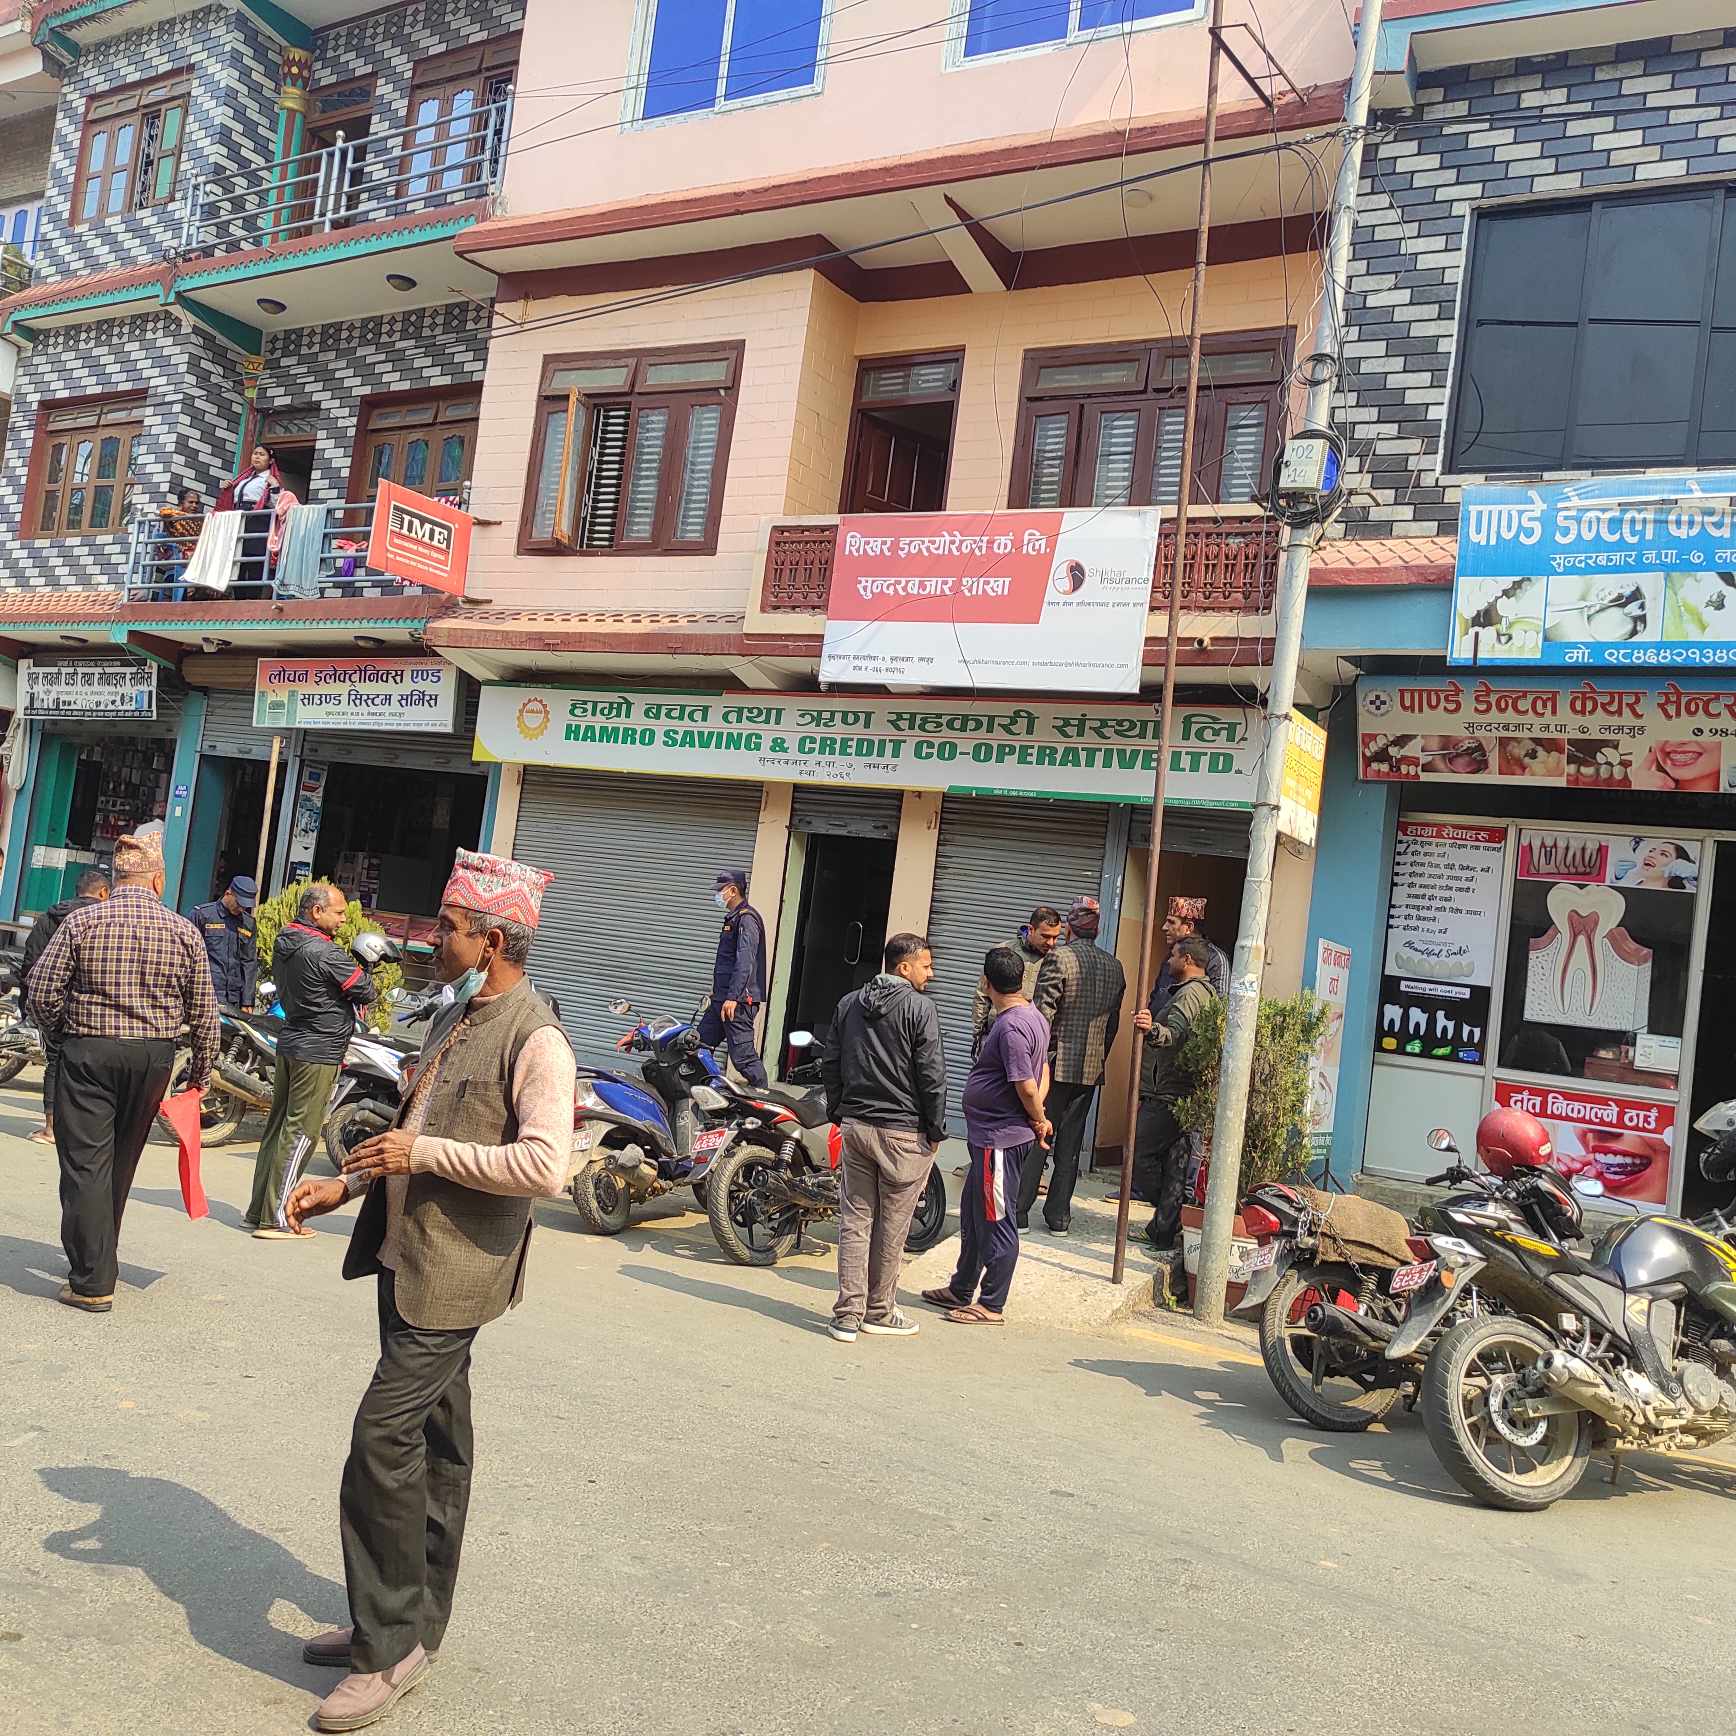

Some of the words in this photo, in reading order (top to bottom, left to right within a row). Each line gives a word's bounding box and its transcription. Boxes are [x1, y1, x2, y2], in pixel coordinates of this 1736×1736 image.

[1468, 491, 1547, 545] पाण्डे
[1668, 480, 1736, 538] केय
[400, 514, 448, 550] IME
[845, 532, 895, 556] शिखर
[1022, 529, 1050, 555] लि.
[1088, 568, 1126, 578] Shikhar
[1550, 552, 1637, 572] सुन्दरबजार
[857, 576, 956, 599] सुन्दरबजार
[960, 576, 1012, 596] शाखा
[1100, 569, 1149, 584] Insurance
[1564, 645, 1593, 663] मो.
[81, 672, 95, 687] तथा
[98, 667, 127, 689] मोबाइल
[268, 665, 309, 684] लोचन
[313, 664, 405, 688] इलेक्ट्रोनिक्स
[410, 668, 442, 684] एण्ड
[300, 693, 341, 708] साउण्ड
[347, 689, 393, 708] सिस्टम
[397, 689, 439, 708] सर्भिस
[1398, 680, 1465, 715] पाण्डे
[1472, 680, 1560, 718] डेन्टल
[1569, 680, 1648, 719] केयर
[569, 696, 635, 720] हाम्रो
[643, 702, 712, 723] बचत
[722, 705, 786, 726] तथा
[796, 708, 876, 729] ऋण
[887, 708, 1040, 736] सहकारी
[1051, 713, 1161, 740] संस्था
[1463, 721, 1533, 735] सुन्दरबजार
[1598, 724, 1648, 738] लमजुङ
[564, 723, 656, 747] HAMRO
[662, 728, 763, 752] SAVING
[769, 736, 789, 753] &
[797, 735, 907, 759] CREDIT
[914, 739, 1159, 771] CO-OPERATIVE
[758, 756, 809, 767] सुन्दरबजार
[1403, 940, 1442, 959] Beautiful
[1509, 1091, 1542, 1113] दाँत
[1547, 1093, 1619, 1124] निकाल्ने
[1624, 1107, 1659, 1129] ठाउँ
